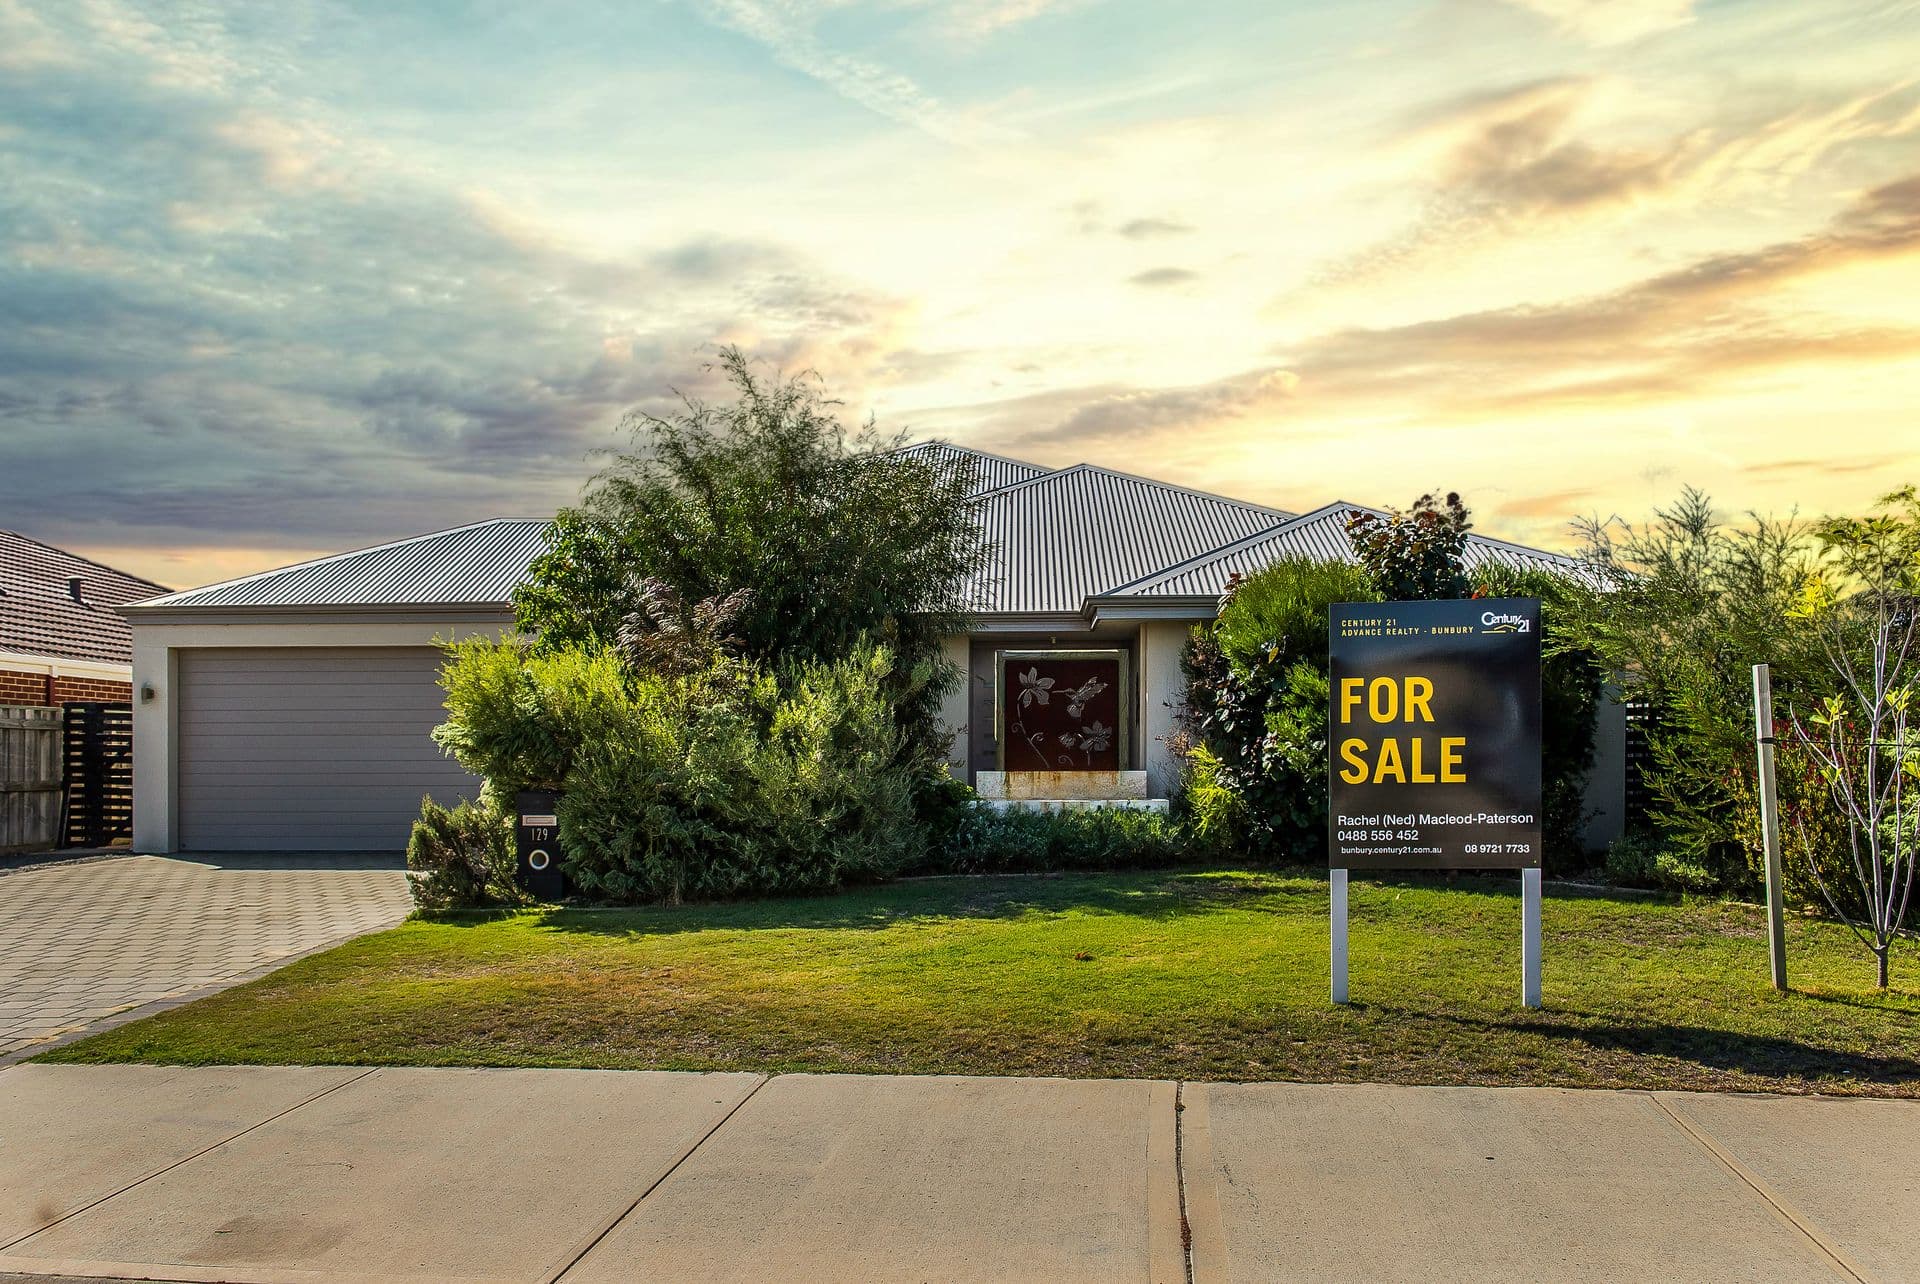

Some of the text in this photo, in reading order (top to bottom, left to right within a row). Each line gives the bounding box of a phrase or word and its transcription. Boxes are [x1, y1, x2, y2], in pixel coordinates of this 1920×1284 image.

[1341, 619, 1382, 627] CENTURY
[1481, 612, 1530, 632] Century 21
[1341, 628, 1382, 636] ADVANCE
[1386, 627, 1420, 635] REALTY
[1432, 626, 1473, 634] BUNBURY
[1340, 677, 1435, 723] FOR
[1339, 737, 1466, 784] SALE
[1338, 813, 1533, 827] Rachel (Ned) Macleod-Paterson
[531, 828, 548, 841] 129
[1338, 830, 1418, 841] 0488 556 452
[1341, 846, 1442, 854] bunbury.century21.com.au
[1465, 844, 1530, 853] 08 9721 7733
